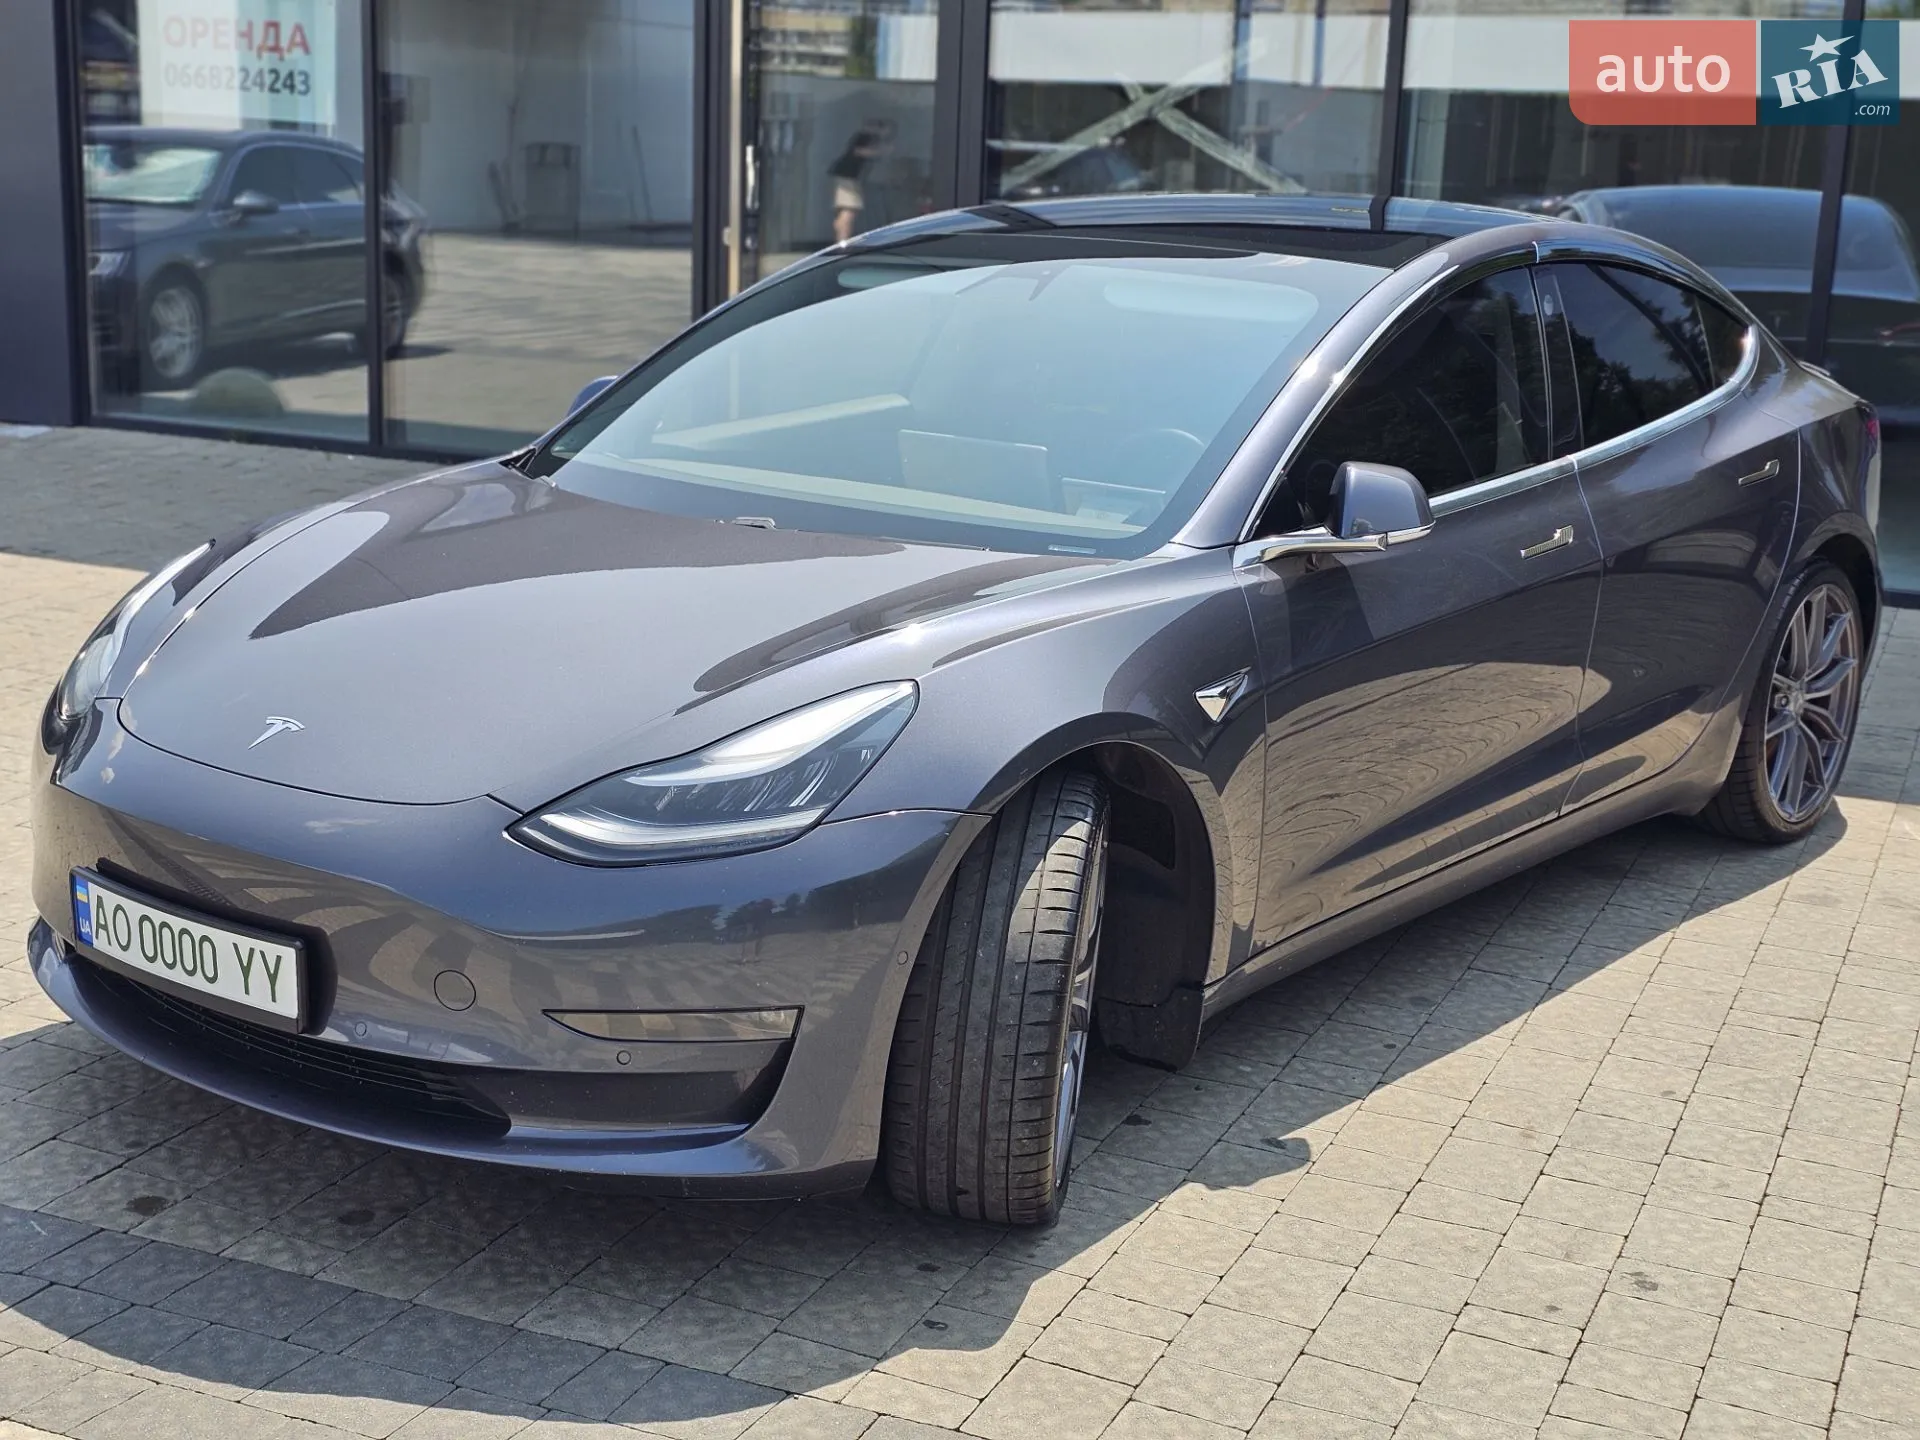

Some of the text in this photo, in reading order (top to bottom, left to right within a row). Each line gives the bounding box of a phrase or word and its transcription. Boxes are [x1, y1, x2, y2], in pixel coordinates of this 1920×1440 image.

[163, 15, 312, 61] ОРЕНДА
[164, 63, 311, 96] 0668224243
[79, 918, 91, 935] UA
[95, 895, 282, 1003] AO 0000 YY
